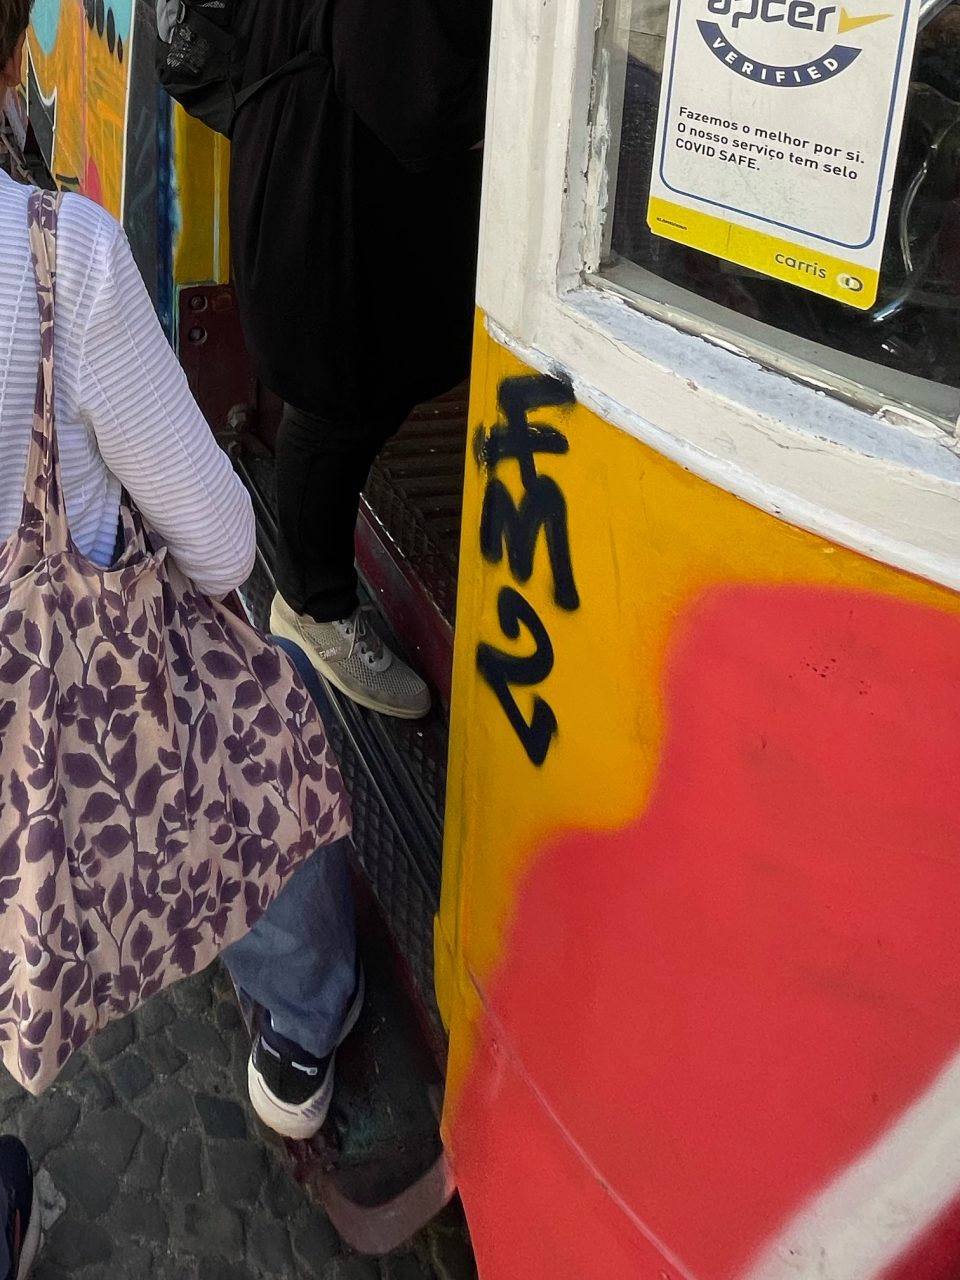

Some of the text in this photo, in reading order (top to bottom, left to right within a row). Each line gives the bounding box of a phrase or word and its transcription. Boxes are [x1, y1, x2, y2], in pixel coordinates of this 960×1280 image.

[712, 37, 839, 83] VERIFIED
[675, 137, 760, 171] COVID SAFE.
[677, 122, 857, 180] O nosso serviço tem selo
[679, 106, 865, 164] Fazemos o melhor por si.
[775, 252, 827, 279] carris
